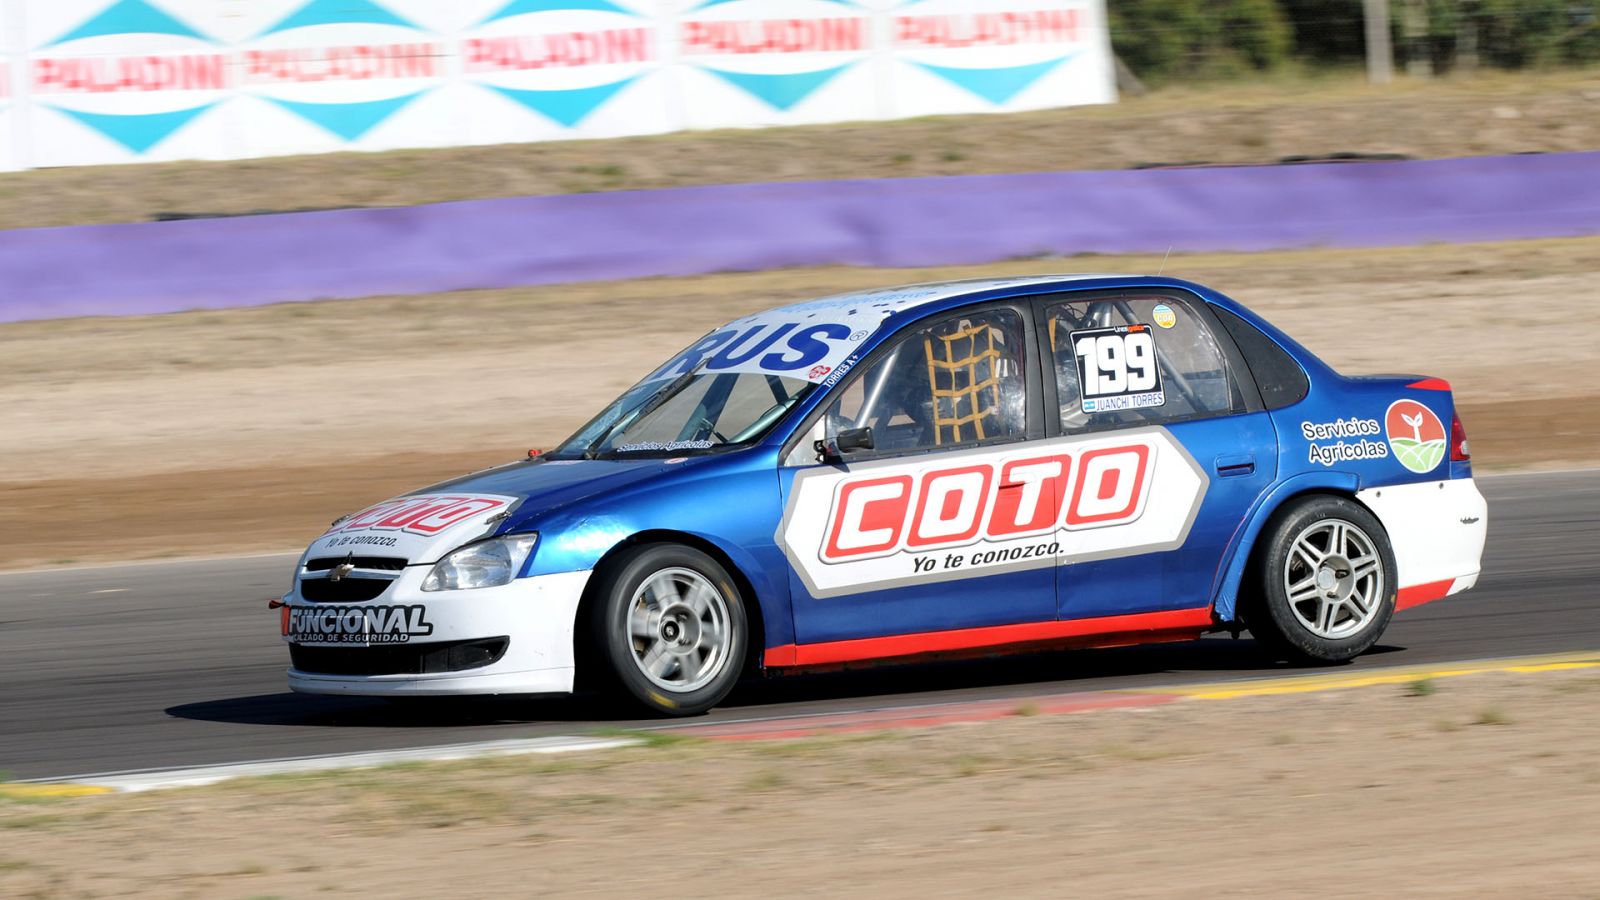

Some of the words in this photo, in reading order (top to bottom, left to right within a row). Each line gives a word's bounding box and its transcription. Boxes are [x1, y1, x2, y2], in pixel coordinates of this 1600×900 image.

[823, 363, 850, 388] TORRES
[1076, 333, 1156, 396] 199
[1096, 397, 1130, 411] JUANCHI
[1131, 392, 1163, 407] TORRES
[1302, 418, 1378, 439] Servicios
[824, 445, 1150, 558] COTO
[913, 556, 937, 573] Yo
[944, 553, 964, 569] te
[970, 541, 1065, 566] conozco.
[288, 606, 431, 634] FUNCIONAL
[327, 633, 339, 643] DE
[342, 633, 410, 643] SEGURIDAD
